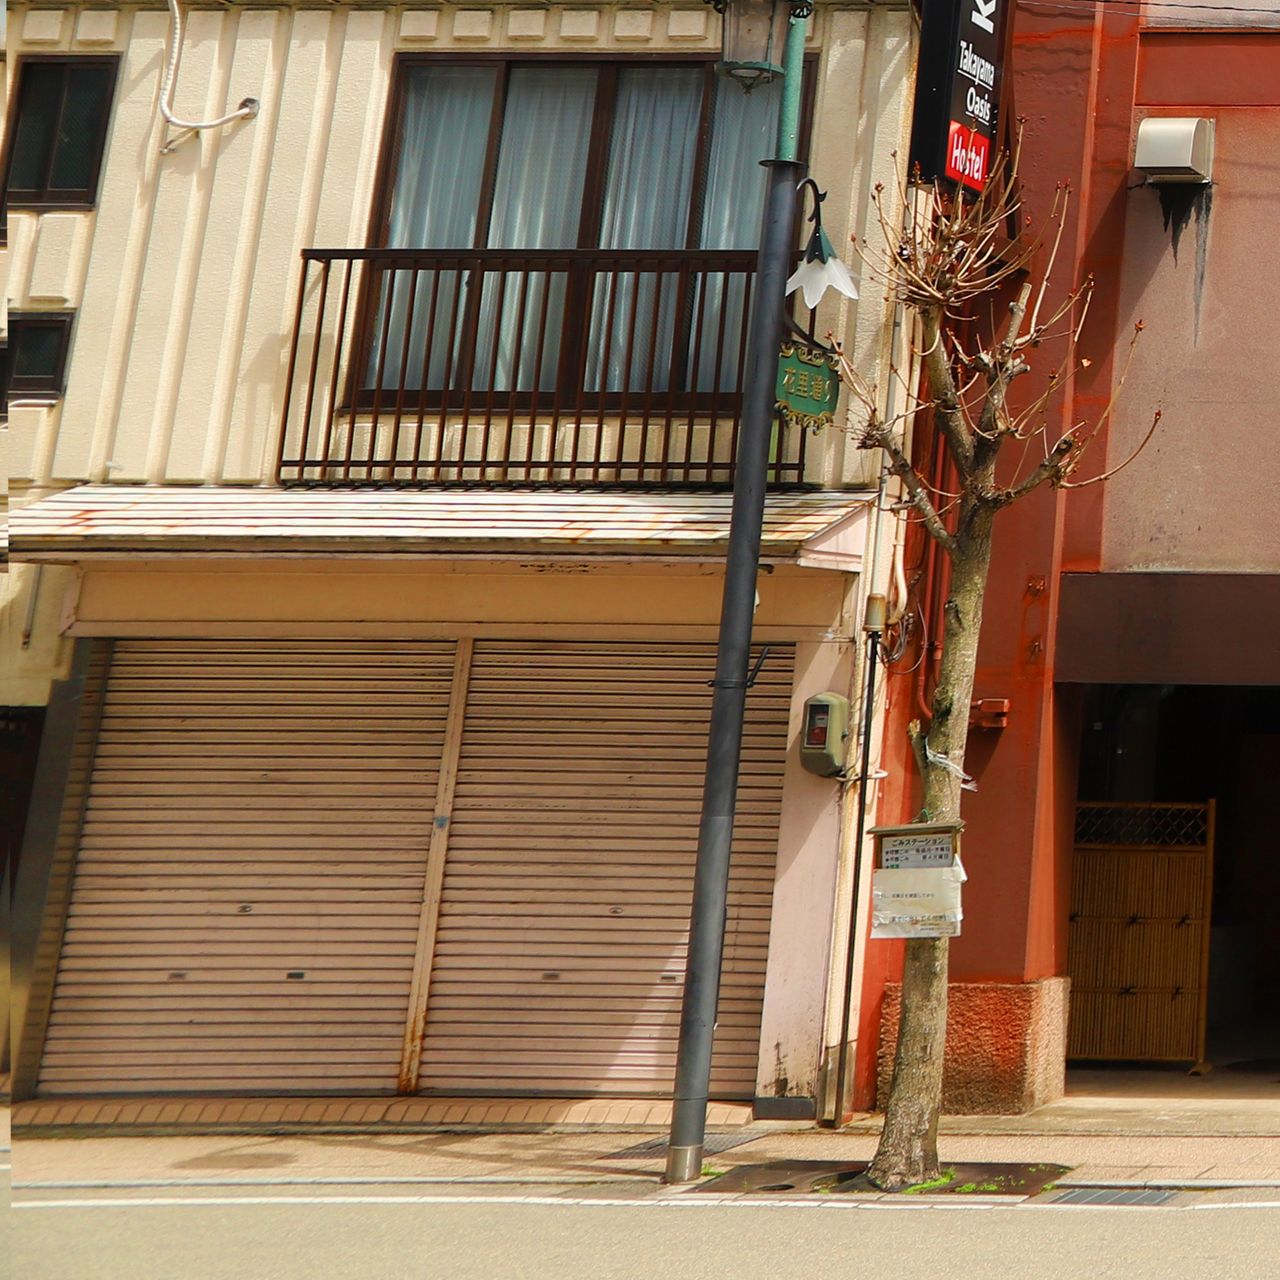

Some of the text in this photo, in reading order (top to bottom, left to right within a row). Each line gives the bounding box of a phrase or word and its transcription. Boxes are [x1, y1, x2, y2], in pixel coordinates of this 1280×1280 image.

[959, 40, 995, 86] Takayama
[966, 86, 991, 121] Oasis
[951, 133, 985, 181] Hostel
